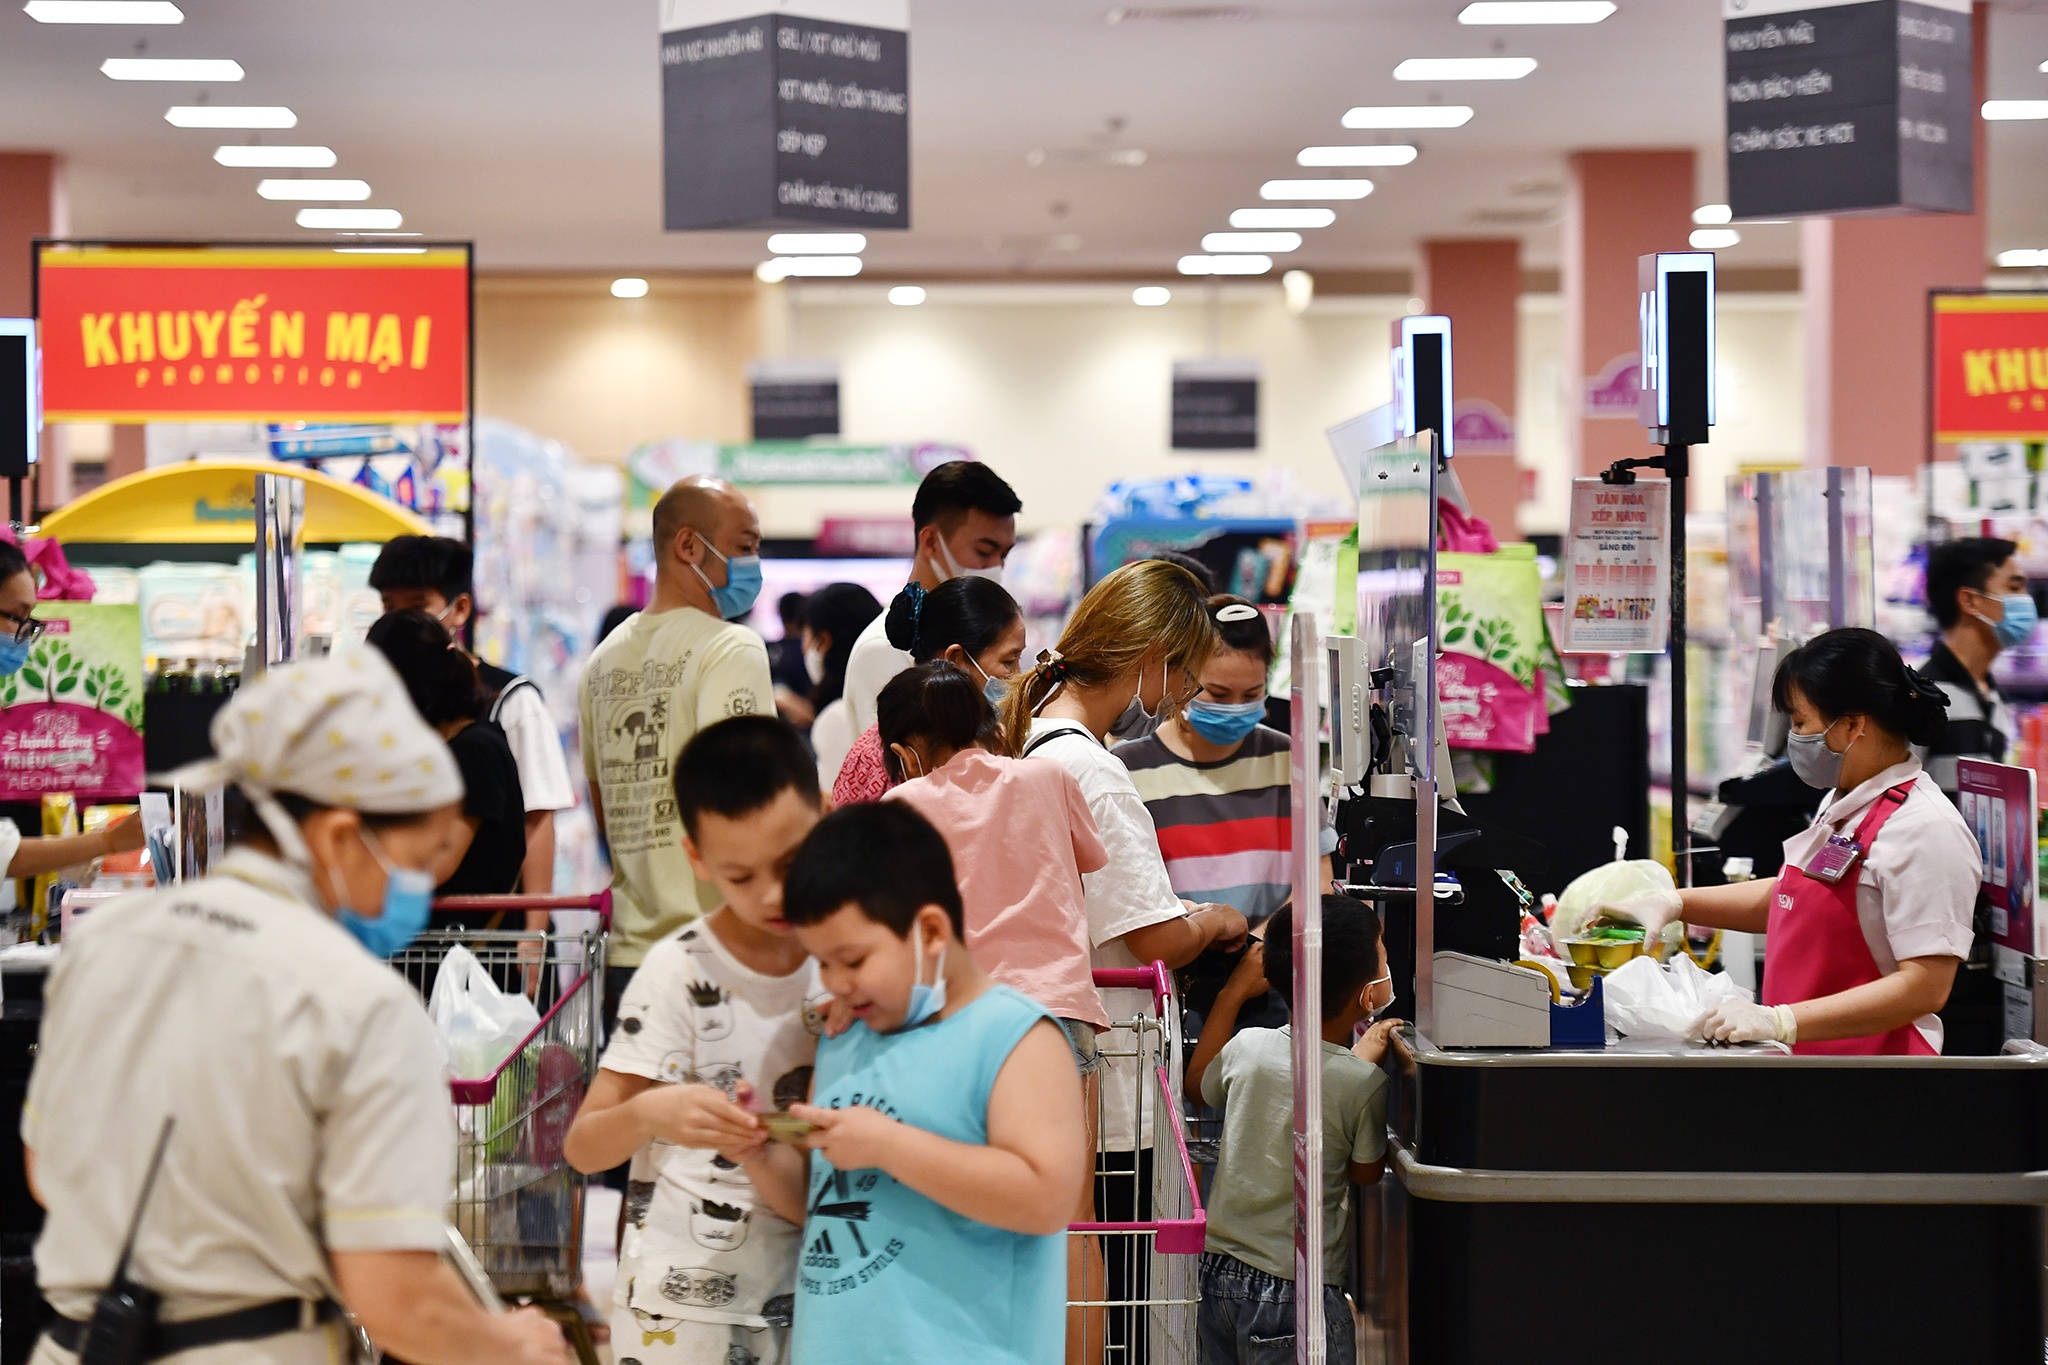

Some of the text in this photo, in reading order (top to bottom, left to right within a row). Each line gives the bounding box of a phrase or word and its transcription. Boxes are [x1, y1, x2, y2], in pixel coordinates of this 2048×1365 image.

[80, 293, 431, 374] KHUYẾN MẠI
[135, 363, 362, 389] PROMOTION
[1596, 492, 1618, 505] VĂN
[1591, 507, 1613, 522] XẾP
[733, 698, 752, 716] 62
[855, 1174, 878, 1192] 49
[804, 1254, 840, 1269] adidas
[828, 1275, 857, 1296] ZERO
